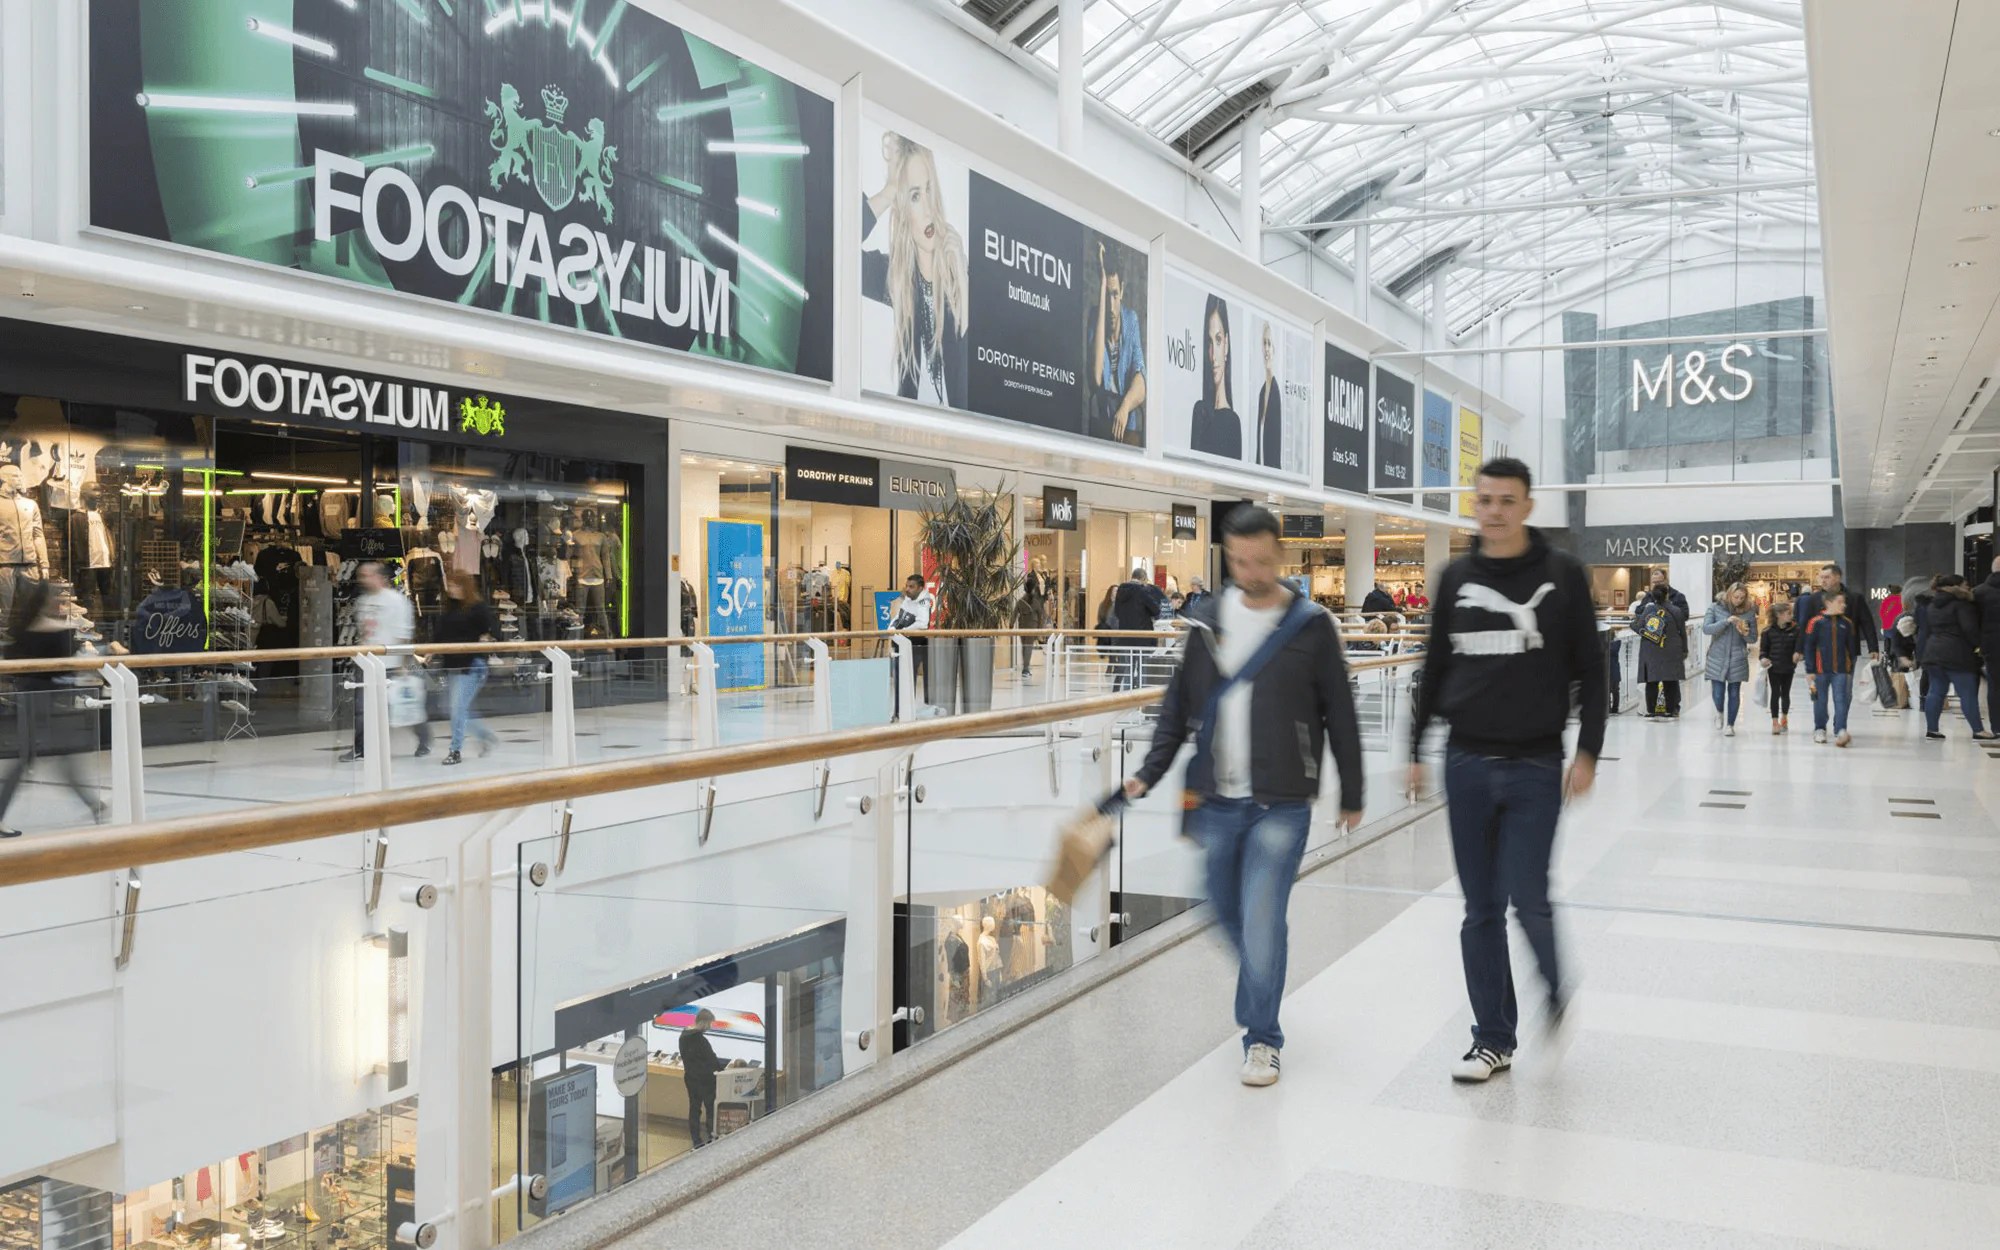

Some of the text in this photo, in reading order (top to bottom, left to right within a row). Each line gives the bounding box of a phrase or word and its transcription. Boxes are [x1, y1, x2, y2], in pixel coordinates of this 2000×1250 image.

[314, 147, 730, 338] FOOTASYLUM
[984, 228, 1072, 290] BURTON
[1008, 280, 1051, 312] burton.co.uk
[977, 346, 1076, 386] DOROTHY PERKINS
[1632, 343, 1753, 412] M&S
[186, 353, 449, 432] FOOTASYLUM
[1328, 374, 1364, 432] JACAMO
[1332, 447, 1344, 463] sizes
[797, 468, 874, 487] DOROTHY PERKINS
[889, 475, 947, 498] BURTON
[1175, 514, 1196, 529] EVANS
[1605, 531, 1805, 557] MARKS & SPENCER
[1871, 587, 1892, 600] M&
[145, 612, 200, 648] Offers
[549, 1082, 566, 1099] MAKE
[549, 1086, 589, 1110] YOURS TODAY
